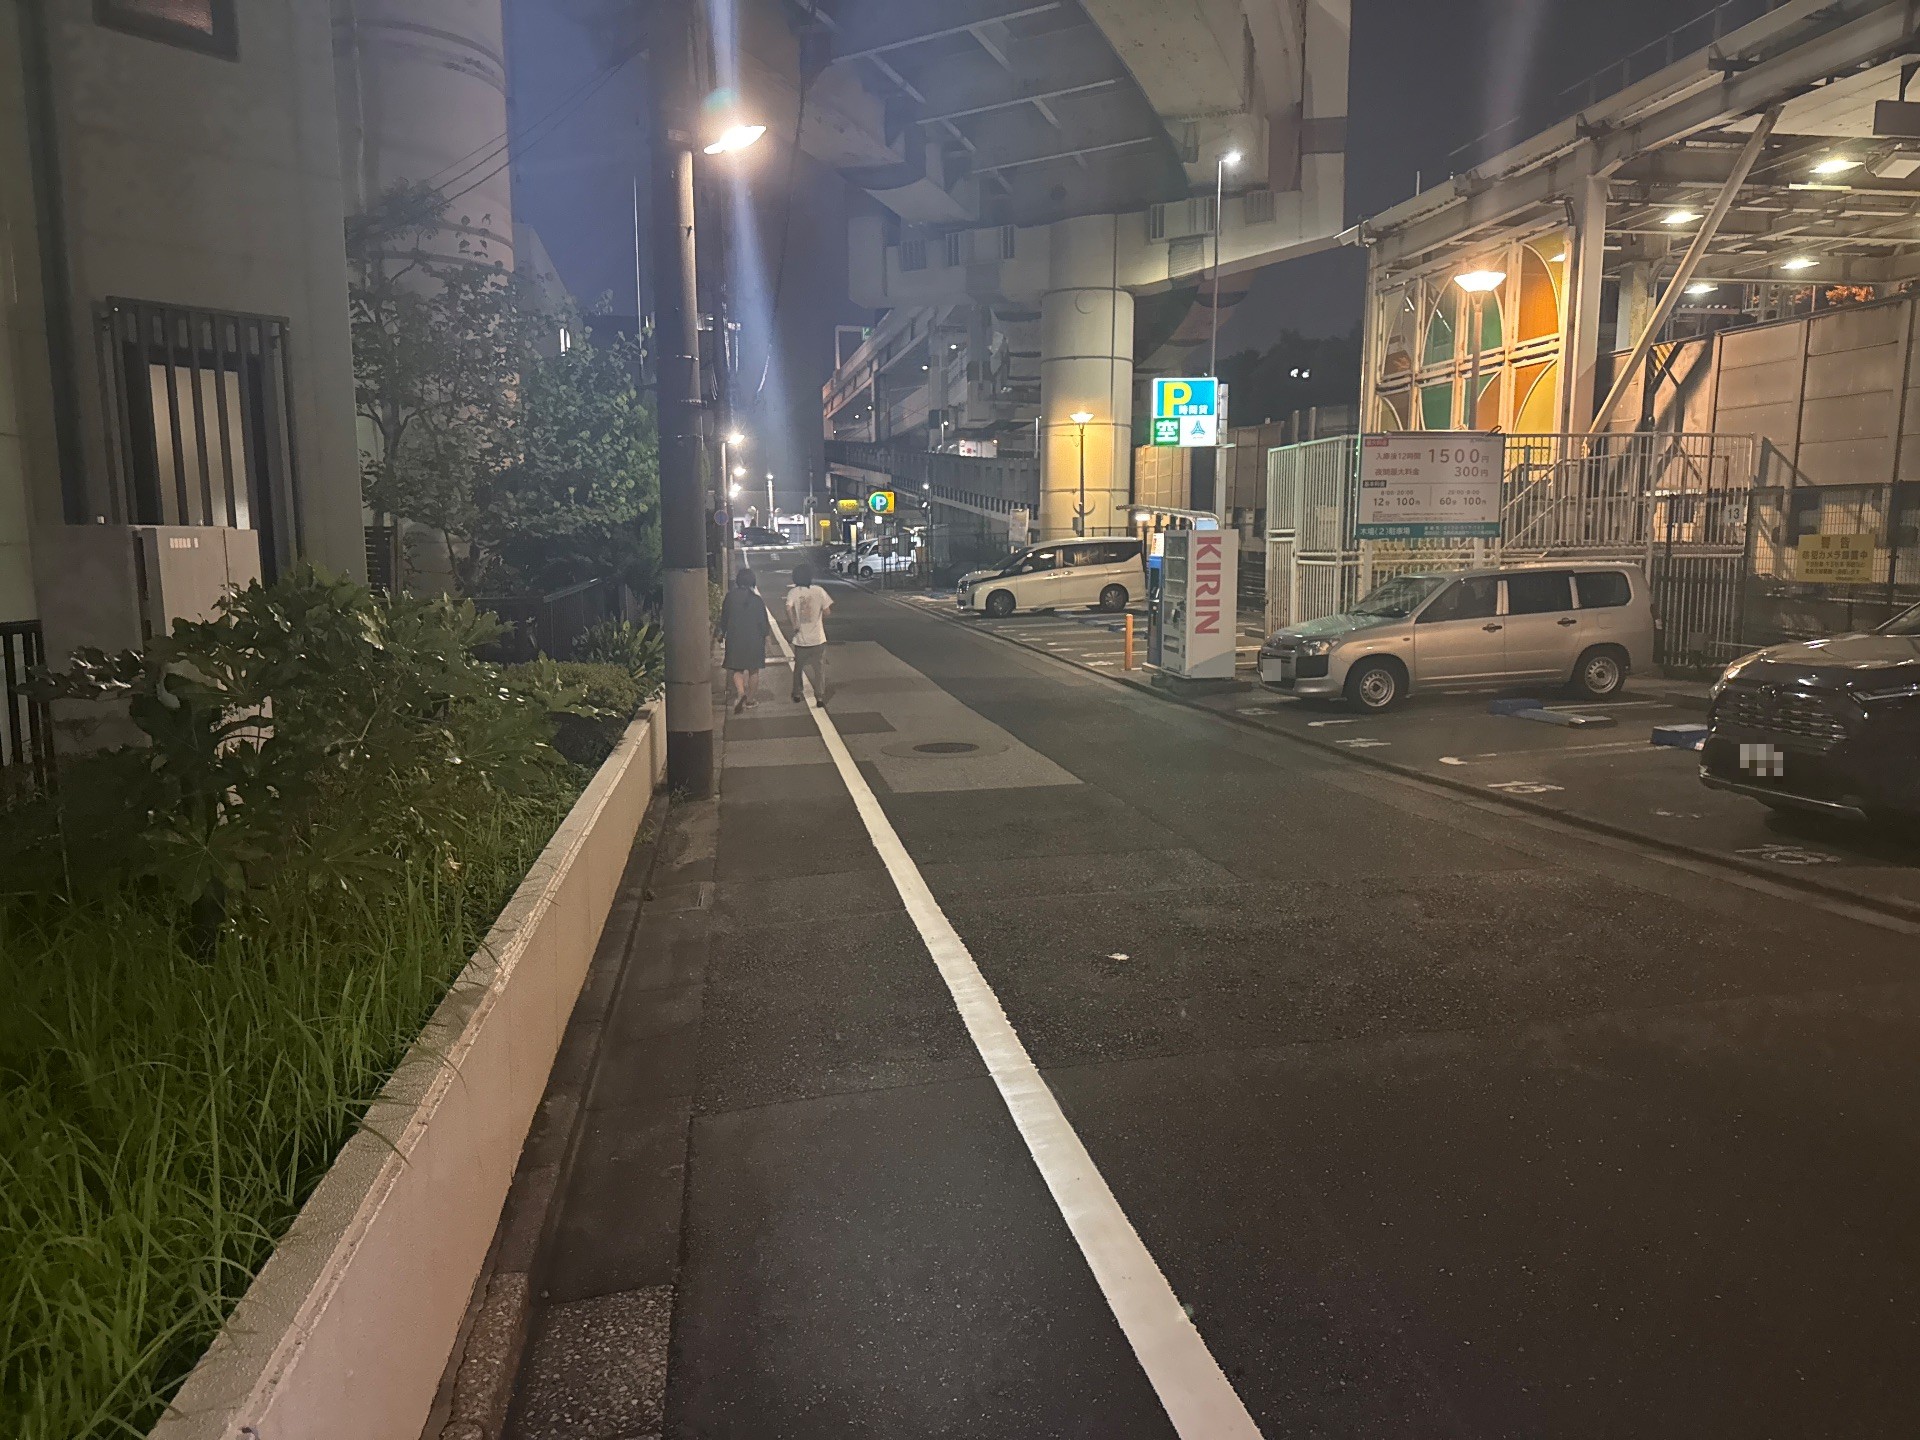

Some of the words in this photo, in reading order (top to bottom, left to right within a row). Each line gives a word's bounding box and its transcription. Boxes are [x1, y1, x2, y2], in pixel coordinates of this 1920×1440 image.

[1163, 382, 1192, 417] P
[1155, 420, 1178, 443] 空
[1455, 466, 1488, 477] 300円
[876, 495, 887, 510] P
[1728, 507, 1740, 519] 13
[1195, 536, 1222, 634] KIRIN
